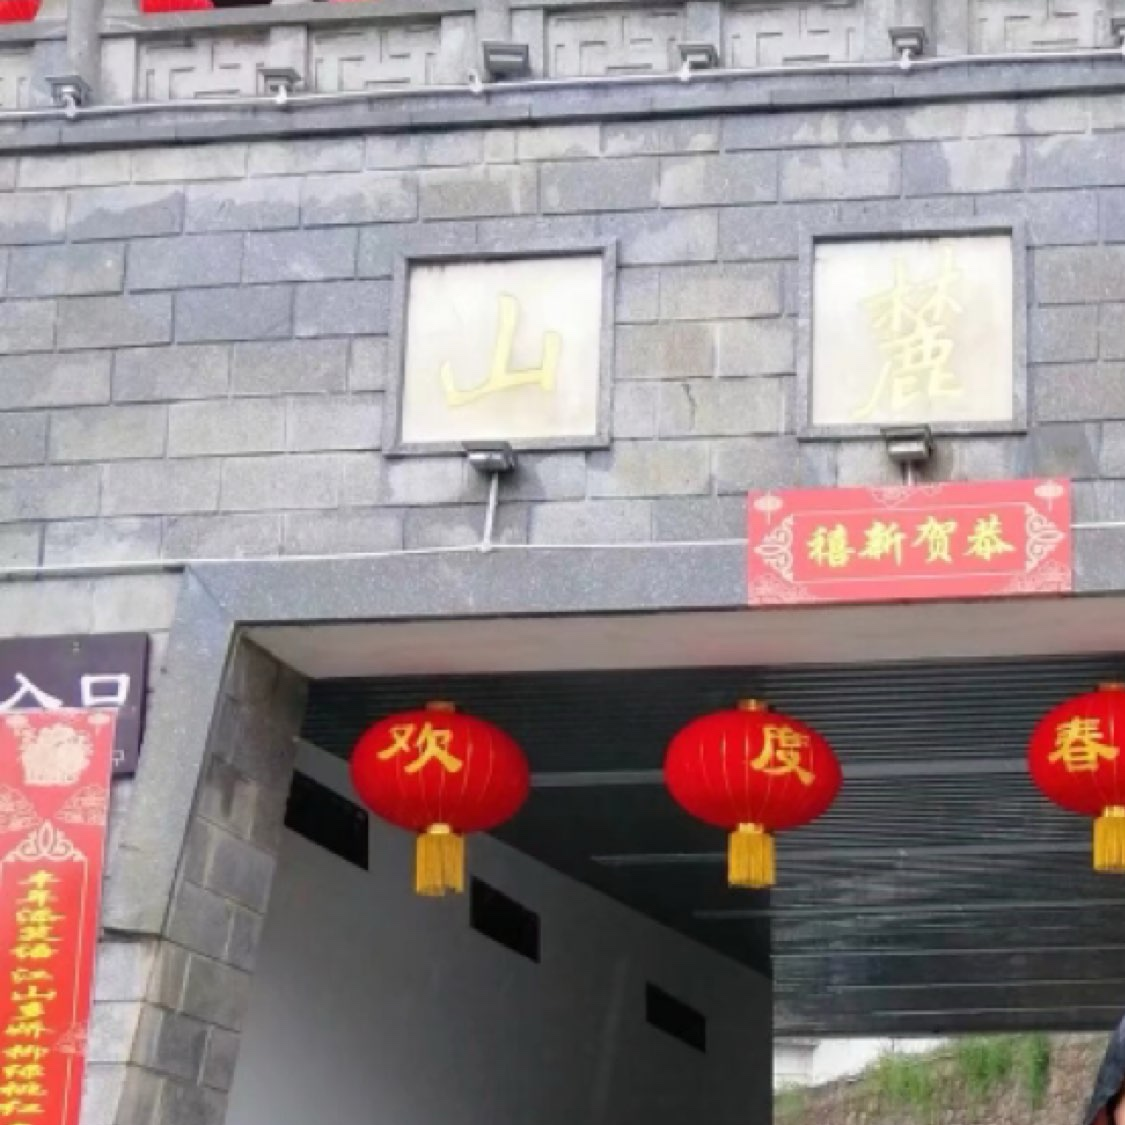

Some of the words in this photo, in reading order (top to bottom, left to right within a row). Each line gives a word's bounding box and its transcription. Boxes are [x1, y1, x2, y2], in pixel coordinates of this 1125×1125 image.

[440, 291, 563, 407] 山
[850, 245, 968, 420] 麓
[0, 672, 130, 708] 入口
[376, 721, 463, 774] 欢
[751, 723, 816, 786] 度
[1048, 715, 1120, 773] 春
